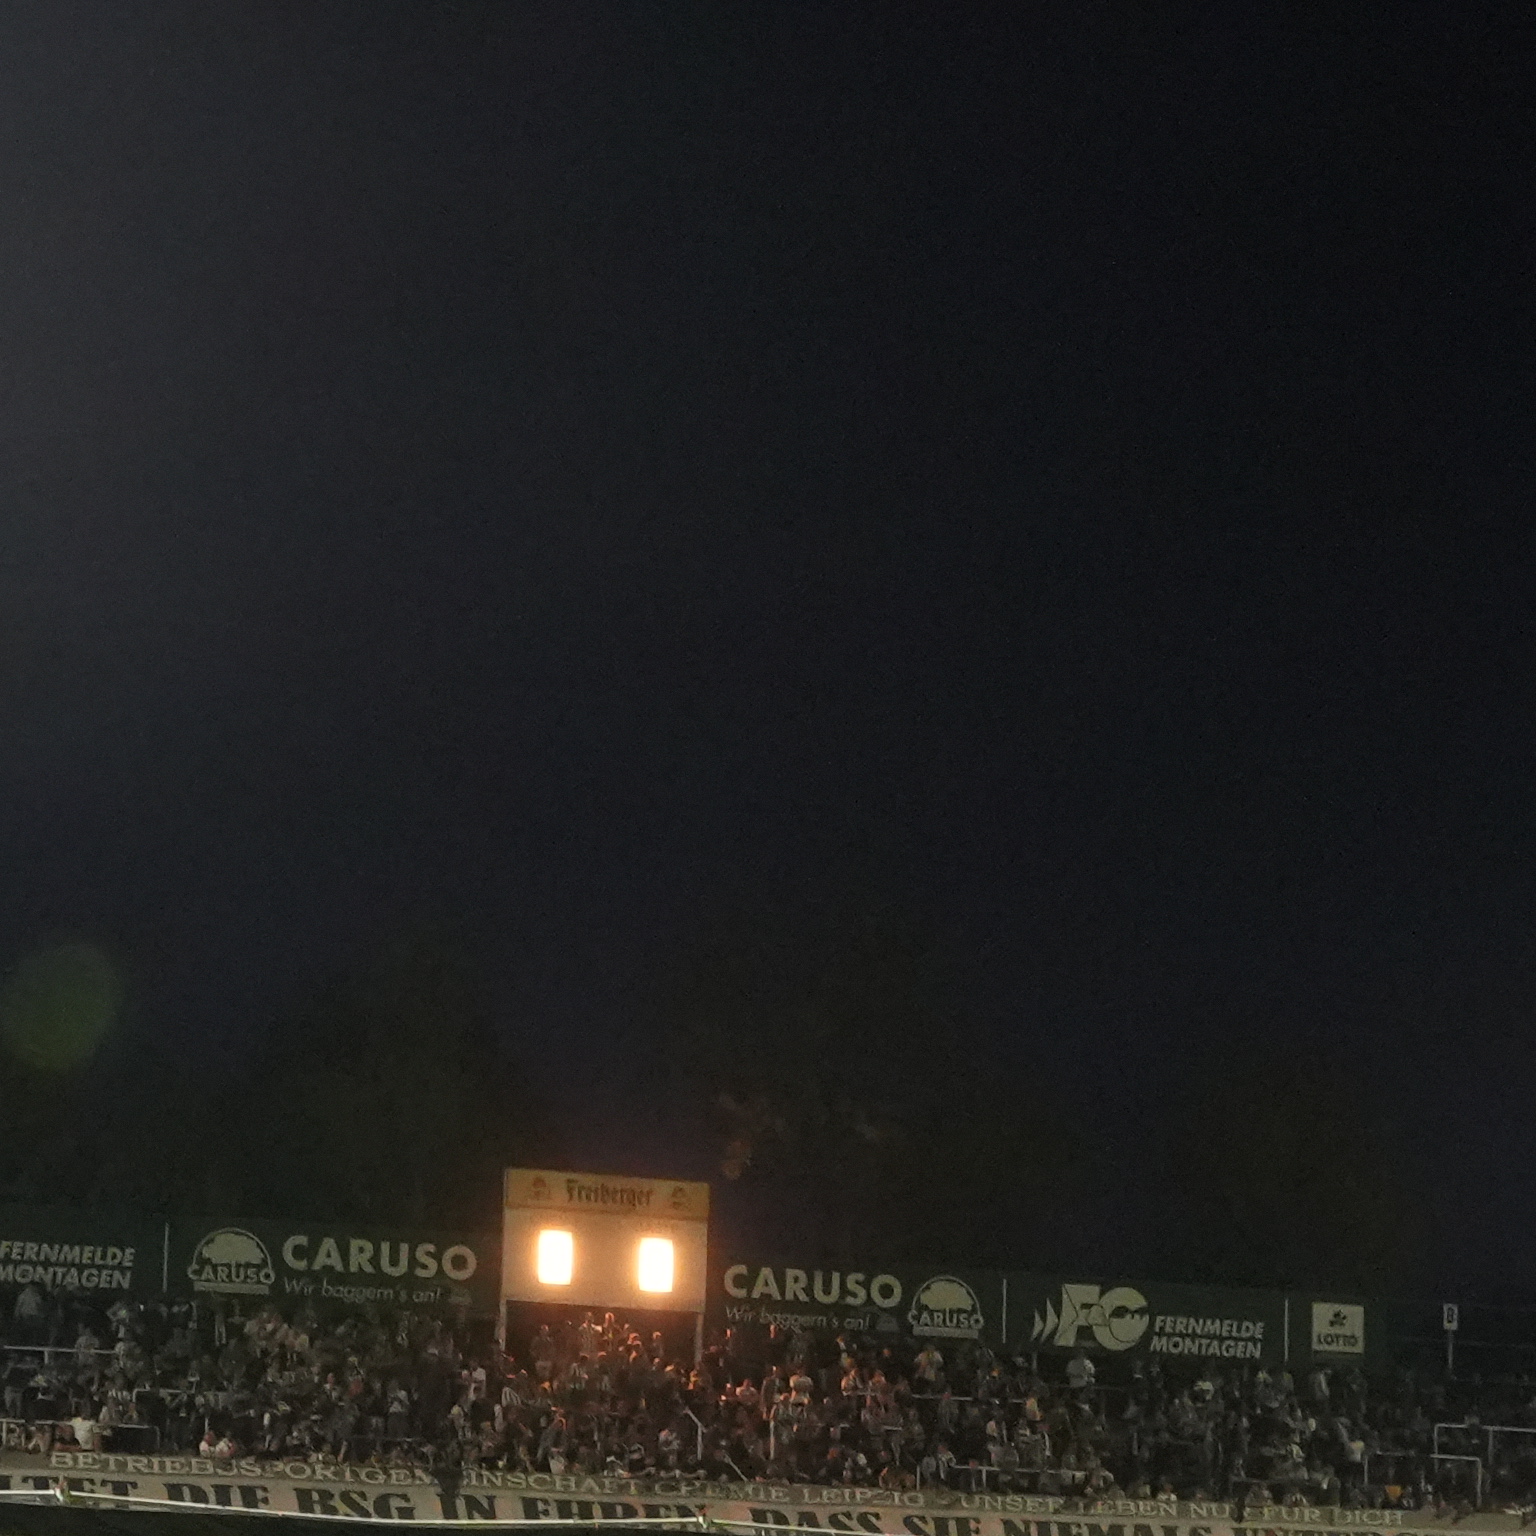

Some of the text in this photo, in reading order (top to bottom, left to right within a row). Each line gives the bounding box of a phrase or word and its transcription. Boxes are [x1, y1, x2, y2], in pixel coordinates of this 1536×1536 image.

[282, 1235, 477, 1280] CARUSO
[187, 1264, 275, 1285] CARUSO
[284, 1277, 315, 1295] Wir
[724, 1264, 902, 1308] CARUSO
[725, 1305, 755, 1322] Wir
[908, 1310, 984, 1329] CARUSO
[1154, 1314, 1265, 1340] FERNMELDE
[1150, 1335, 1261, 1358] MONTAGEN
[1317, 1333, 1358, 1347] LOTTO
[164, 1483, 269, 1508] DIE
[294, 1487, 414, 1519] BSG
[436, 1493, 497, 1519] IN
[802, 1487, 925, 1508] LEIPZIG
[1077, 1501, 1177, 1517] LEBEN
[1333, 1508, 1402, 1526] DICH
